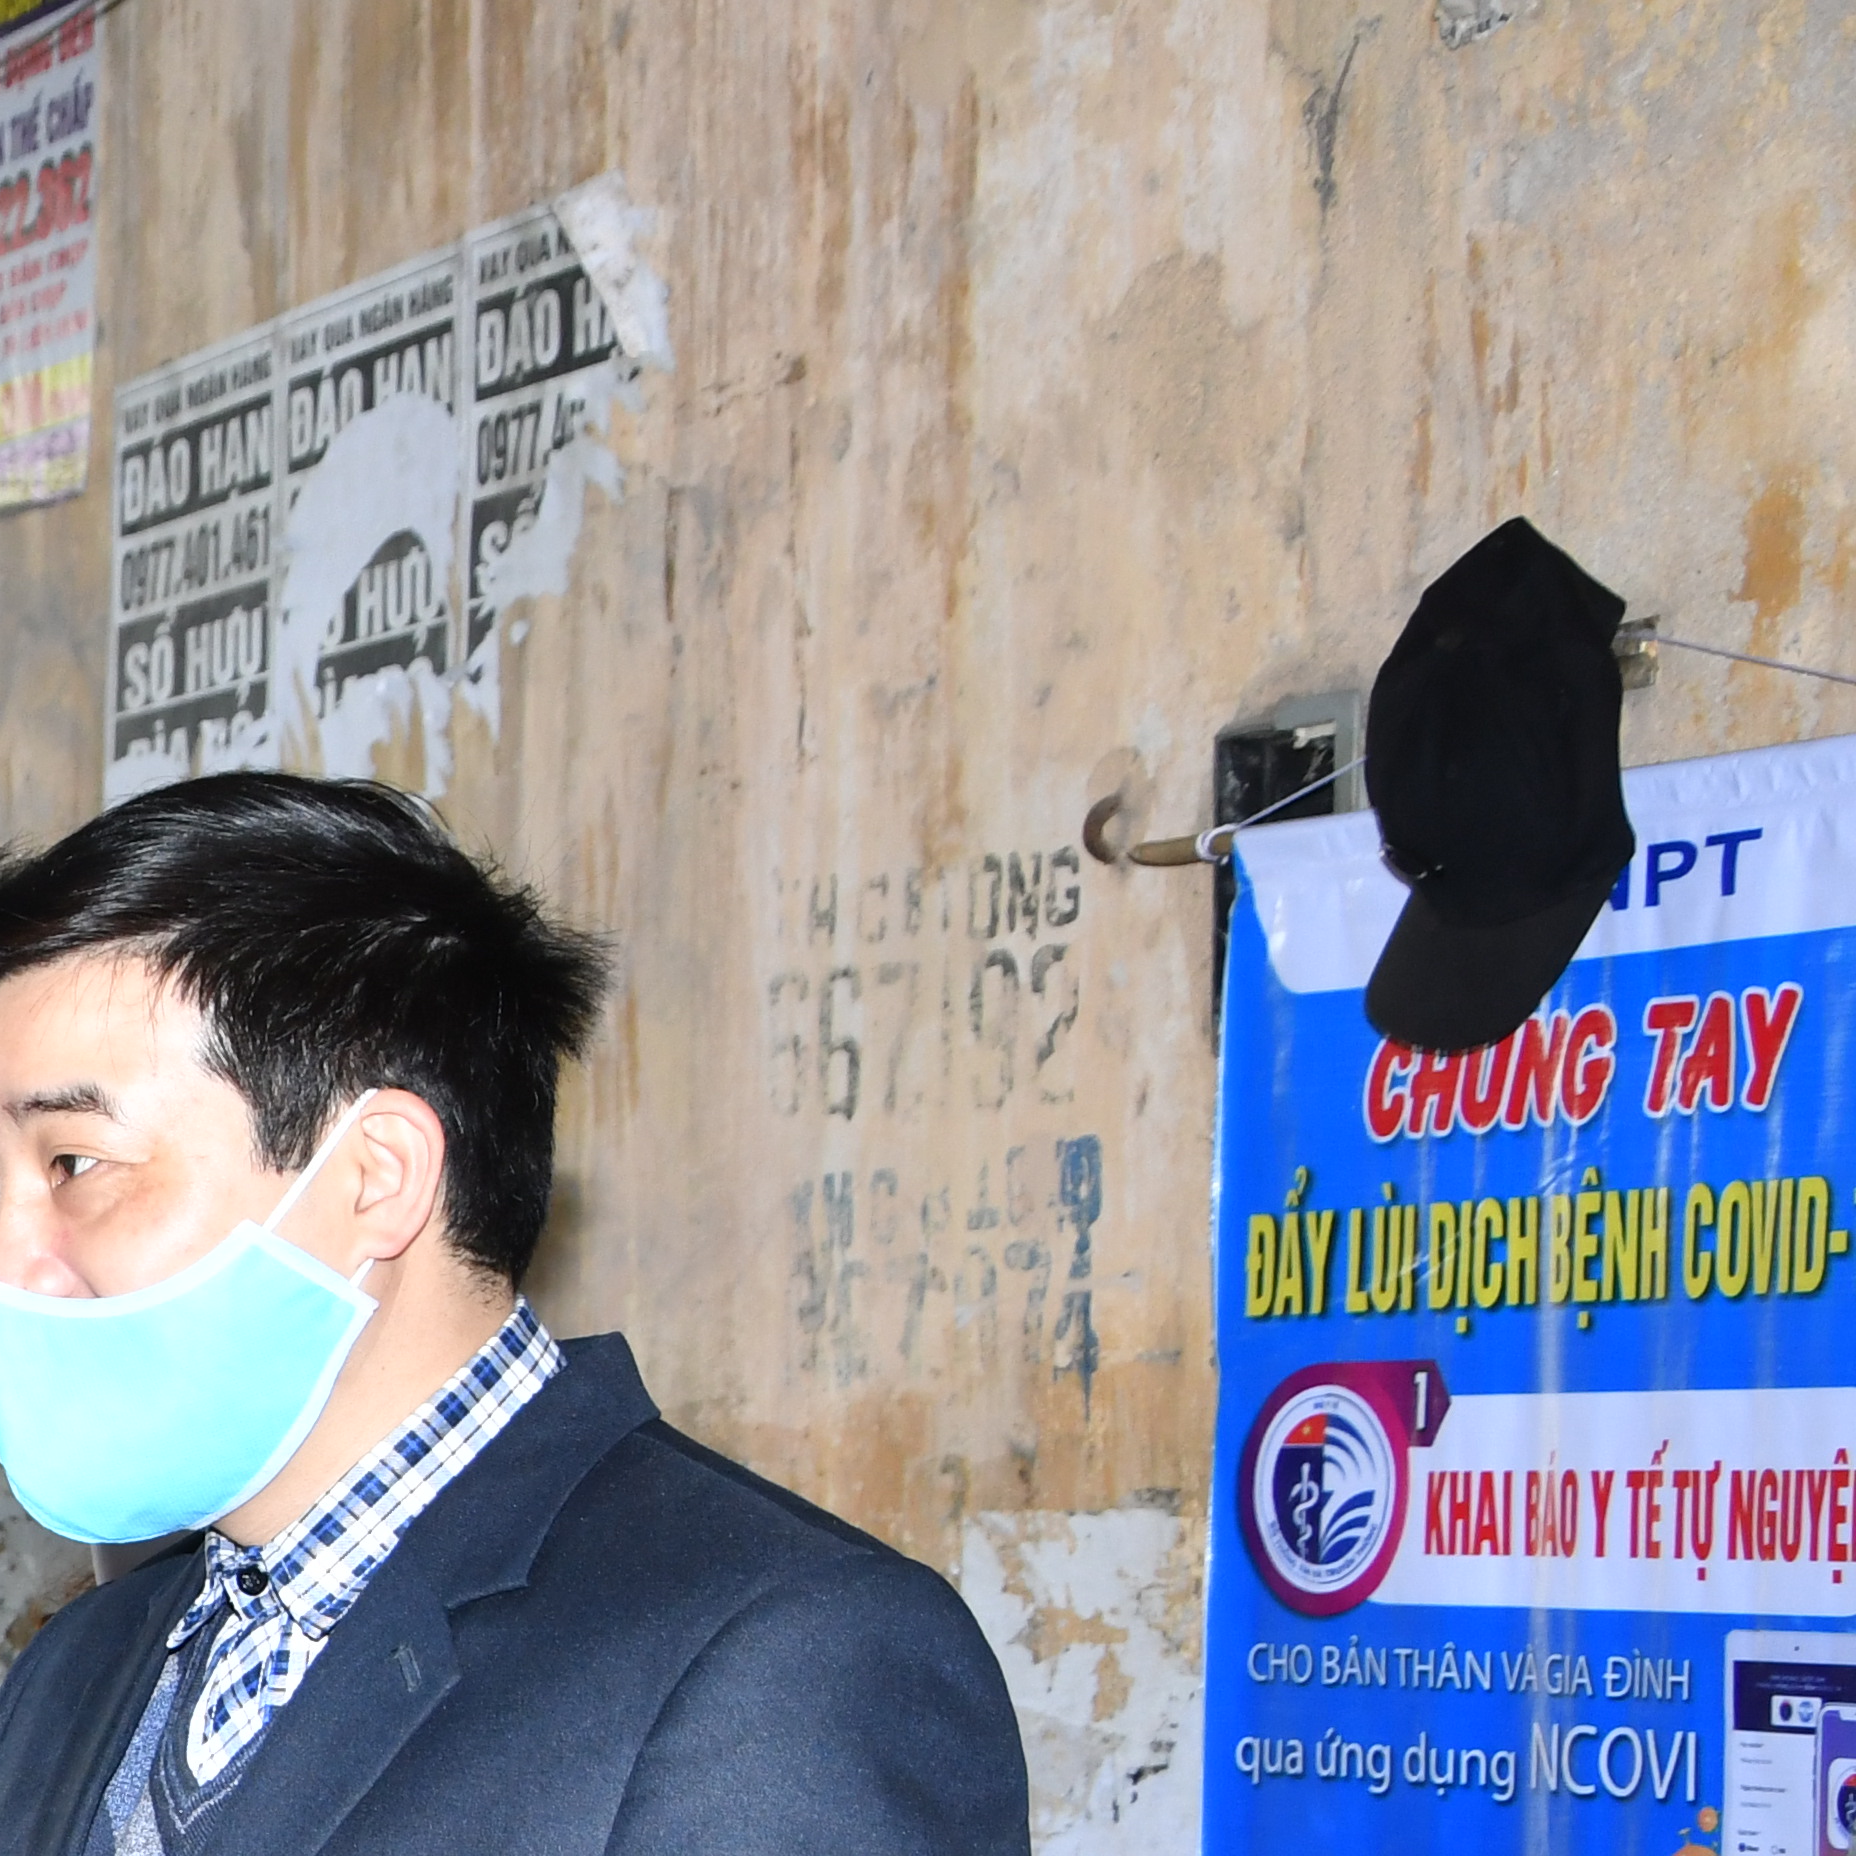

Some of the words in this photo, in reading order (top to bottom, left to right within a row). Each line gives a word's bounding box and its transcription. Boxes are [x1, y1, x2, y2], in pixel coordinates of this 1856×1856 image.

[1643, 982, 1804, 1119] TAY
[1244, 1165, 1335, 1321] ĐẨY
[1344, 1181, 1418, 1315] LÙI
[1428, 1195, 1539, 1335] DỊCH
[1549, 1167, 1669, 1329] BỆNH
[1681, 1173, 1856, 1299] COVID-
[1423, 1470, 1513, 1556] KHAI
[1524, 1449, 1579, 1559] BÁO
[1591, 1469, 1616, 1558] Y
[1626, 1438, 1670, 1559] TẾ
[1673, 1459, 1722, 1582] TỰ
[1246, 1641, 1313, 1685] CHO
[1321, 1634, 1387, 1688] BẢN
[1393, 1641, 1492, 1692] THÂN
[1502, 1644, 1539, 1694] VÀ
[1544, 1653, 1594, 1698] GIA
[1603, 1655, 1691, 1701] ĐÌNH
[1235, 1733, 1304, 1779] qua
[1315, 1726, 1392, 1796] ứng
[1403, 1731, 1517, 1801] dụng
[1529, 1721, 1698, 1803] NCOVI
